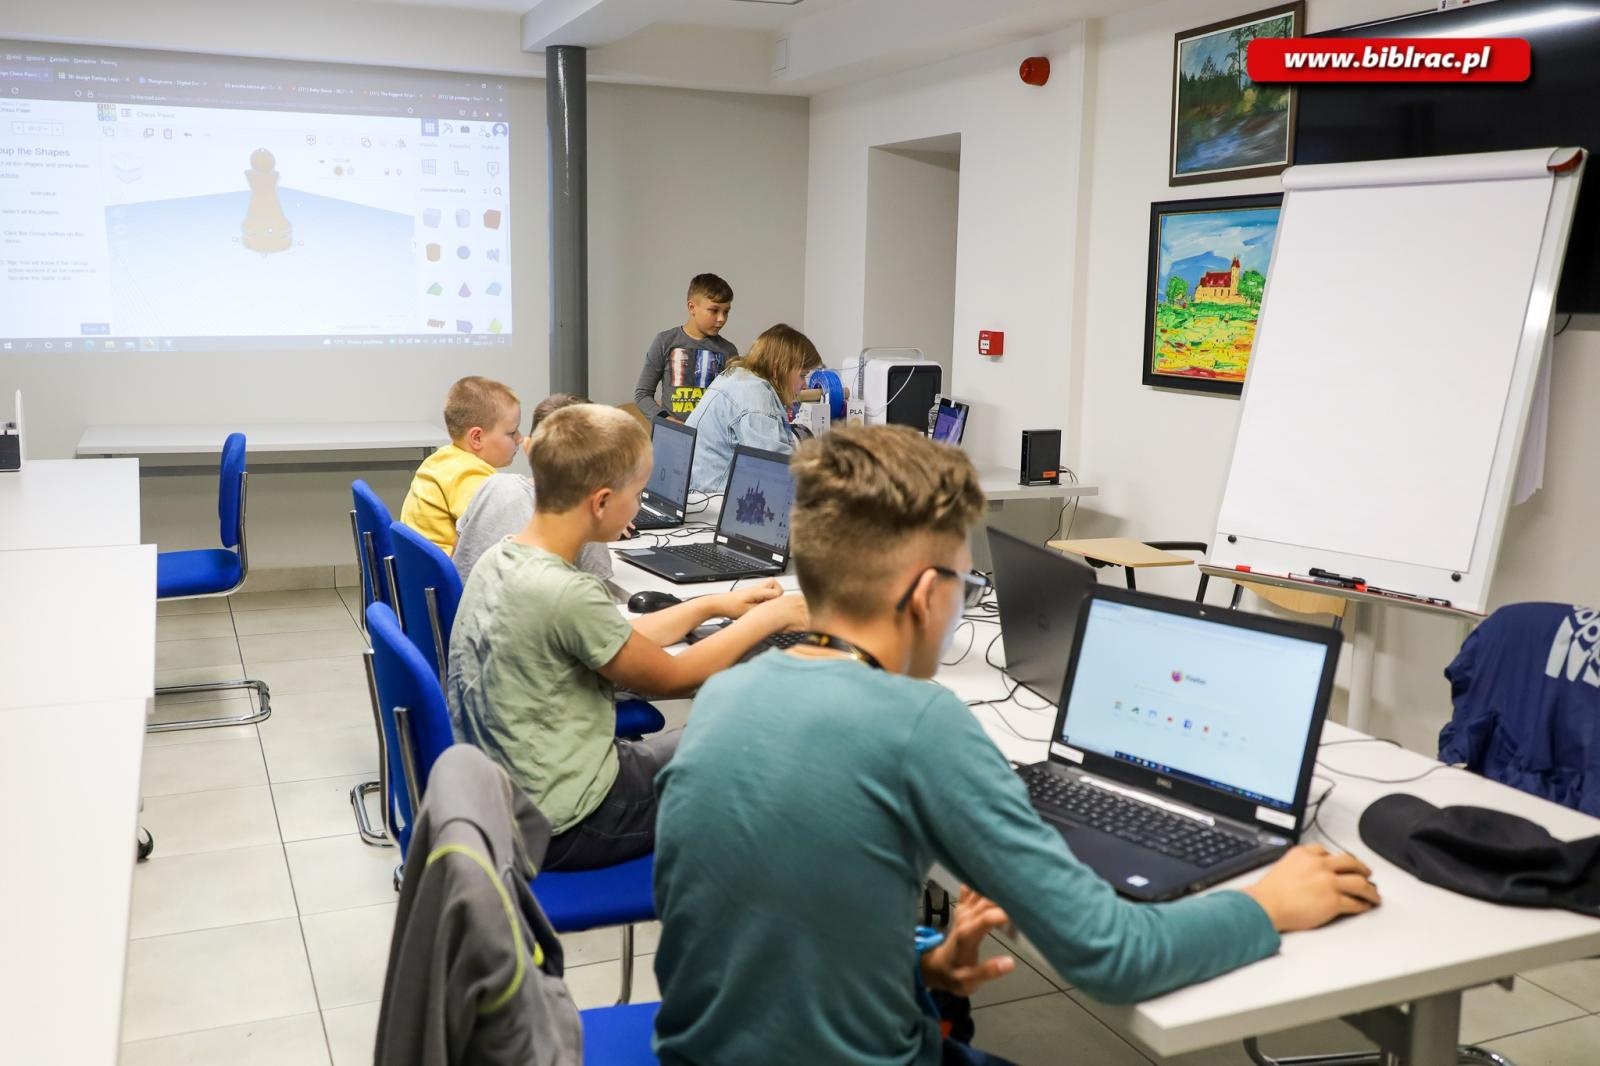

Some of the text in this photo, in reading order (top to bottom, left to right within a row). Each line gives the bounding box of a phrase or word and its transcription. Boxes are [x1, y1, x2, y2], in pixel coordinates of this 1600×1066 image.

[35, 147, 71, 158] Shapes
[671, 387, 706, 399] STA
[672, 401, 698, 413] WA
